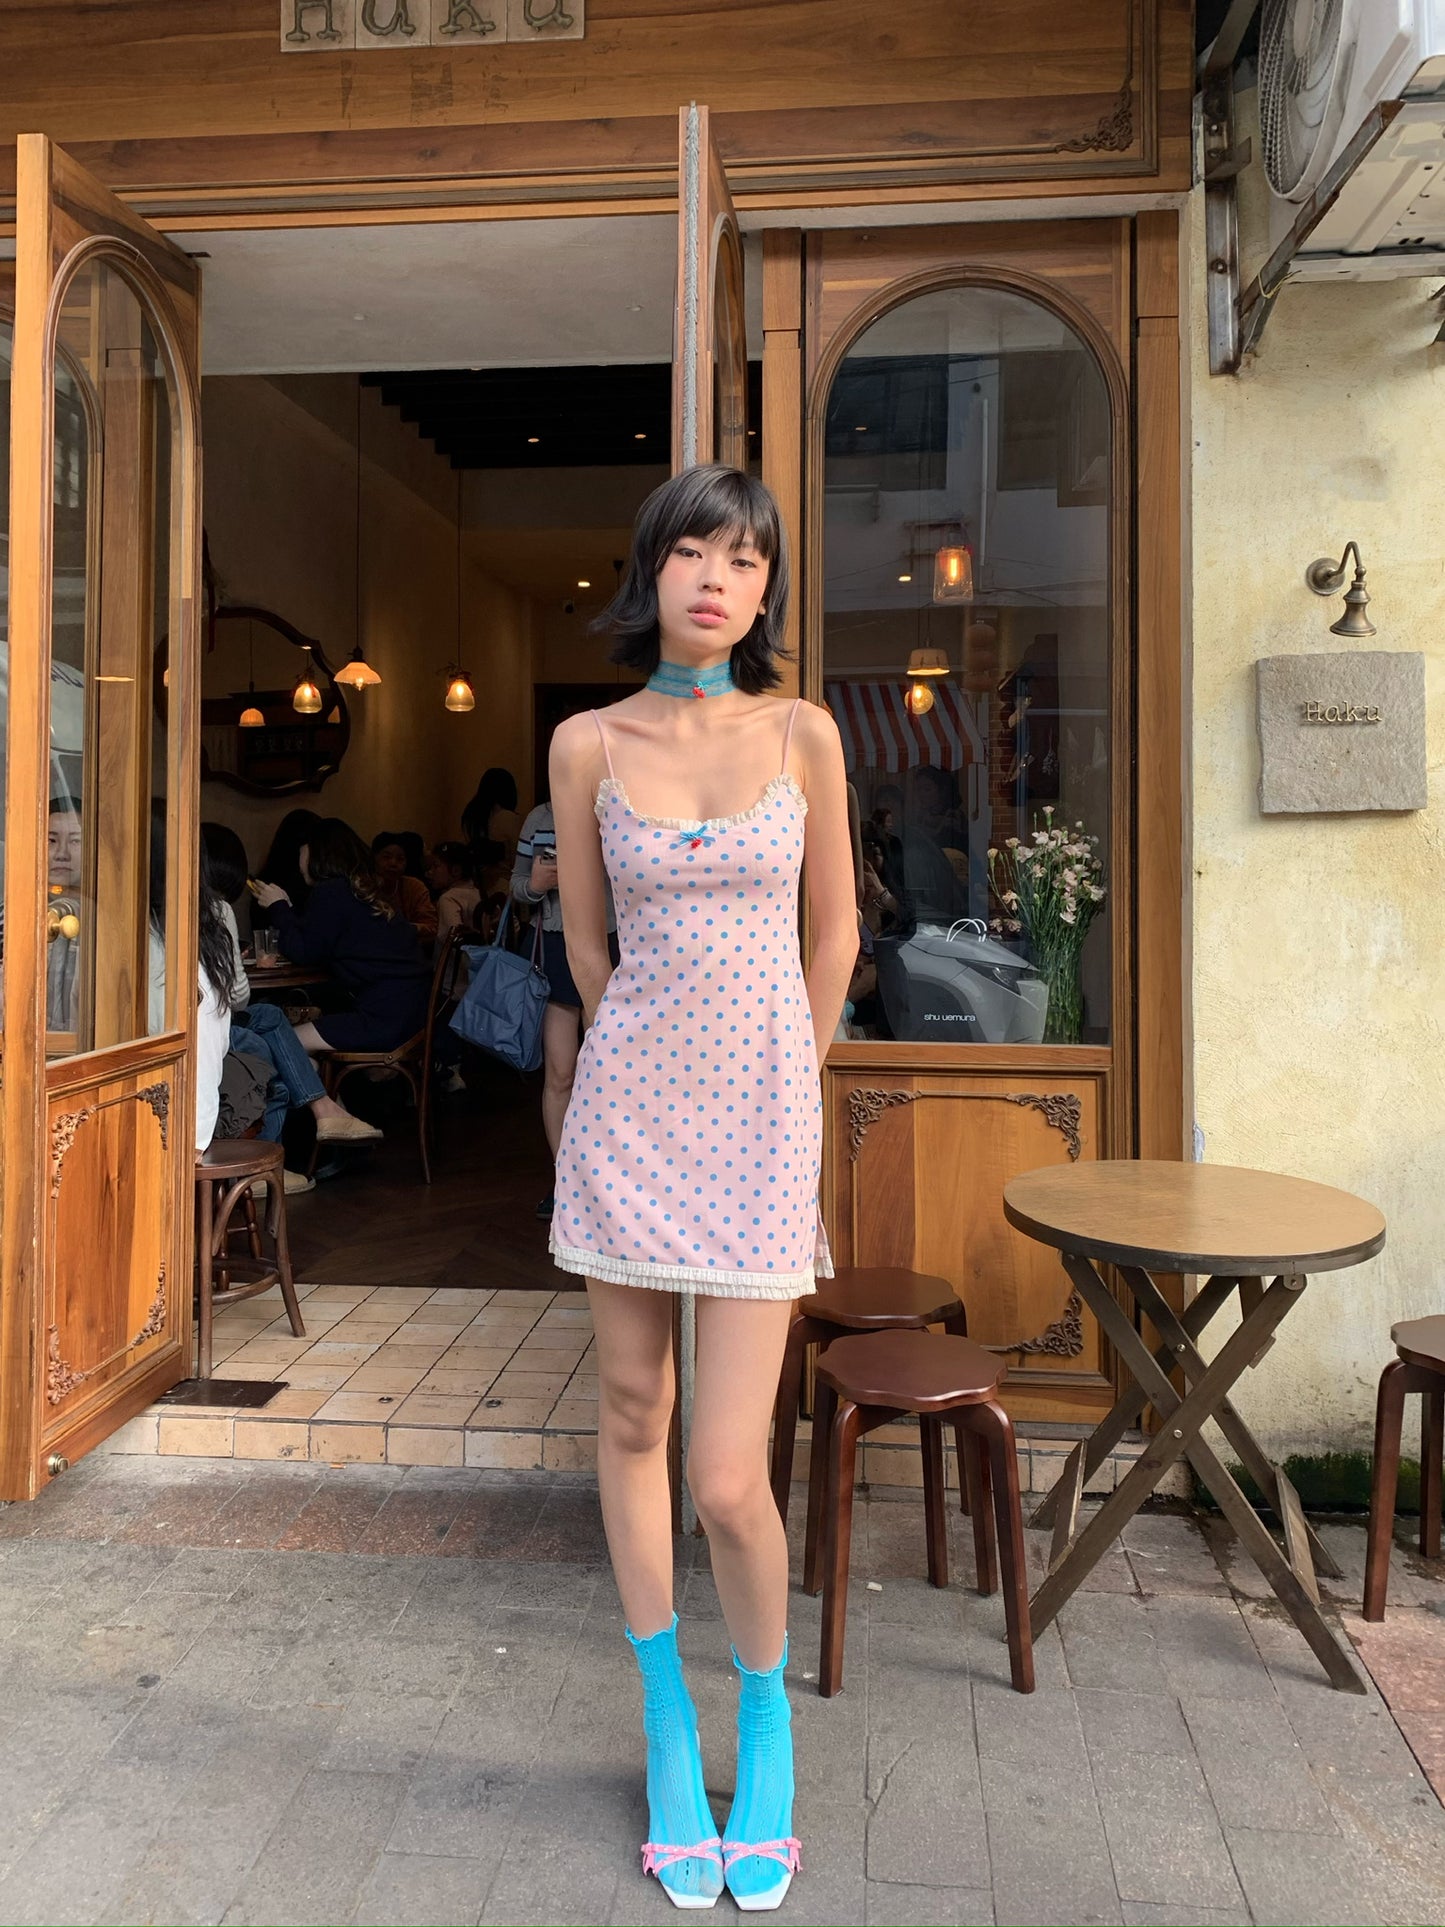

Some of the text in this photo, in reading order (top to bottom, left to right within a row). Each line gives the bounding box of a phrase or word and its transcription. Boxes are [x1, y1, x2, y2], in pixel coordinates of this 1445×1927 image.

[1303, 700, 1383, 722] Haku
[923, 1013, 976, 1022] shu uemura
